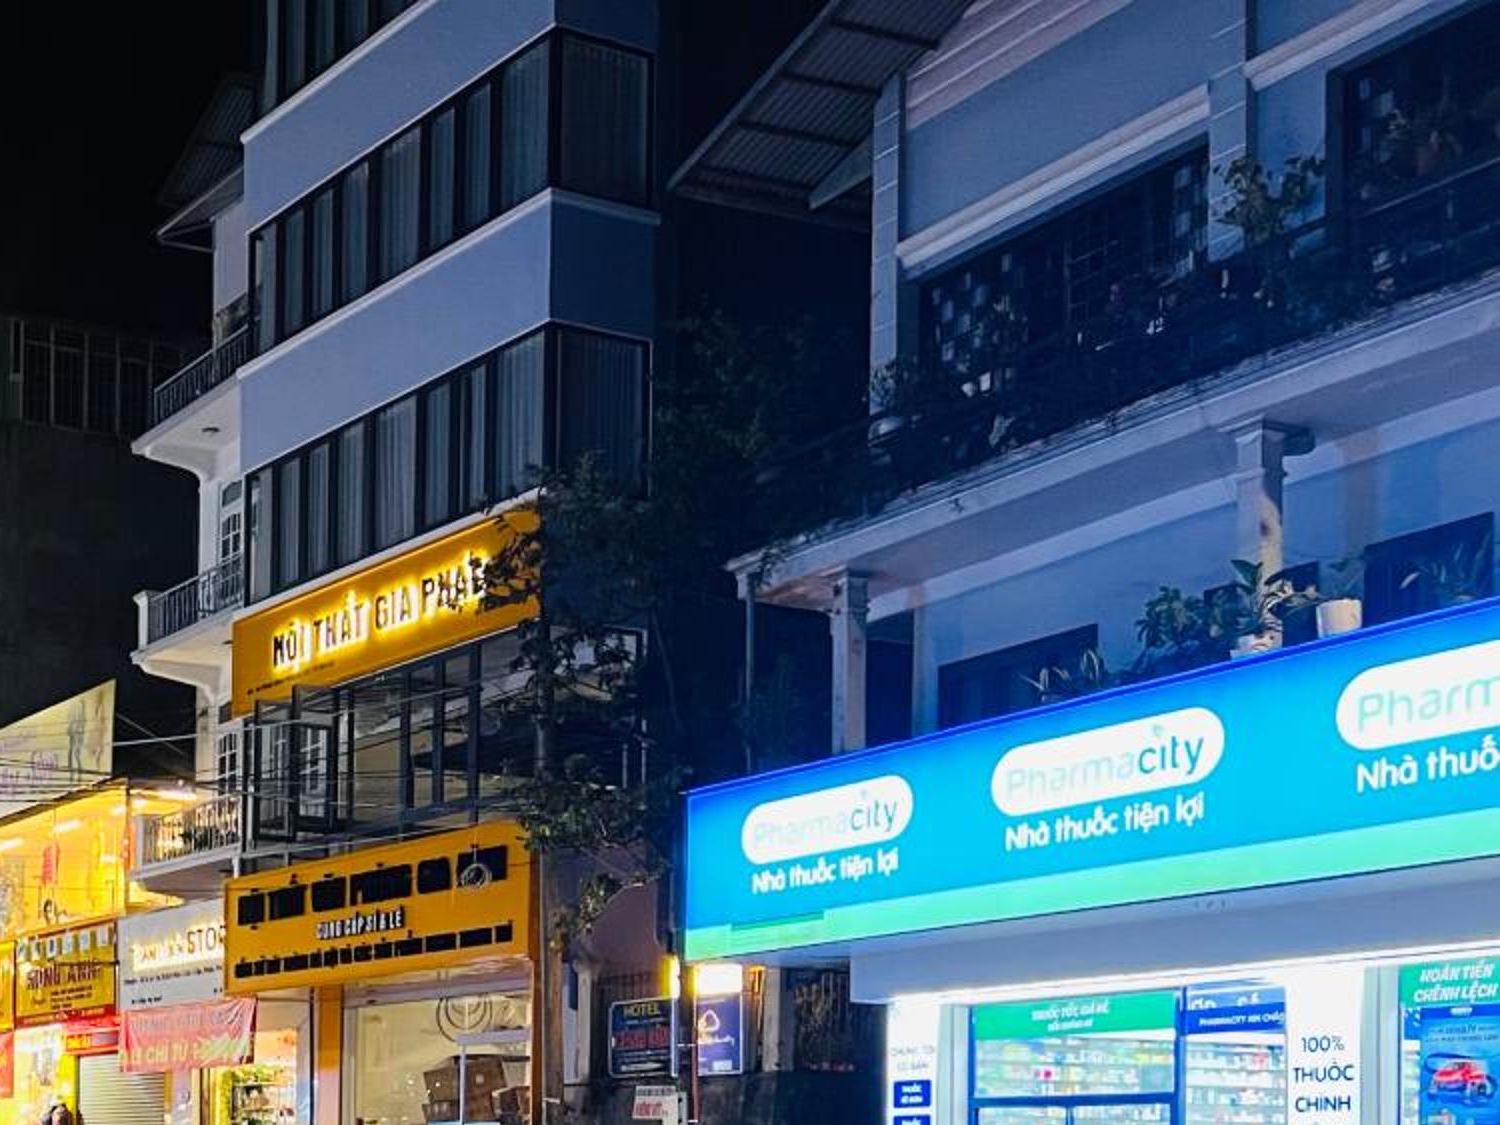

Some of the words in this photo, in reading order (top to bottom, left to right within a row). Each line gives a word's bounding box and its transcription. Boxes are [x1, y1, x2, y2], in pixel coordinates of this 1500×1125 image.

[374, 585, 420, 630] GIA
[1007, 724, 1204, 802] Pharmacity
[1356, 754, 1418, 793] Nhà
[1427, 734, 1500, 780] thuố
[1005, 821, 1049, 851] Nhà
[1055, 805, 1119, 842] thuốc
[1124, 801, 1169, 832] tiện
[1176, 791, 1205, 826] lợi
[752, 868, 785, 894] Nhà
[790, 857, 836, 888] thuốc
[840, 855, 873, 883] tiện
[877, 847, 899, 877] lợi
[1301, 1035, 1345, 1053] 100%
[1292, 1058, 1355, 1084] THUỐC
